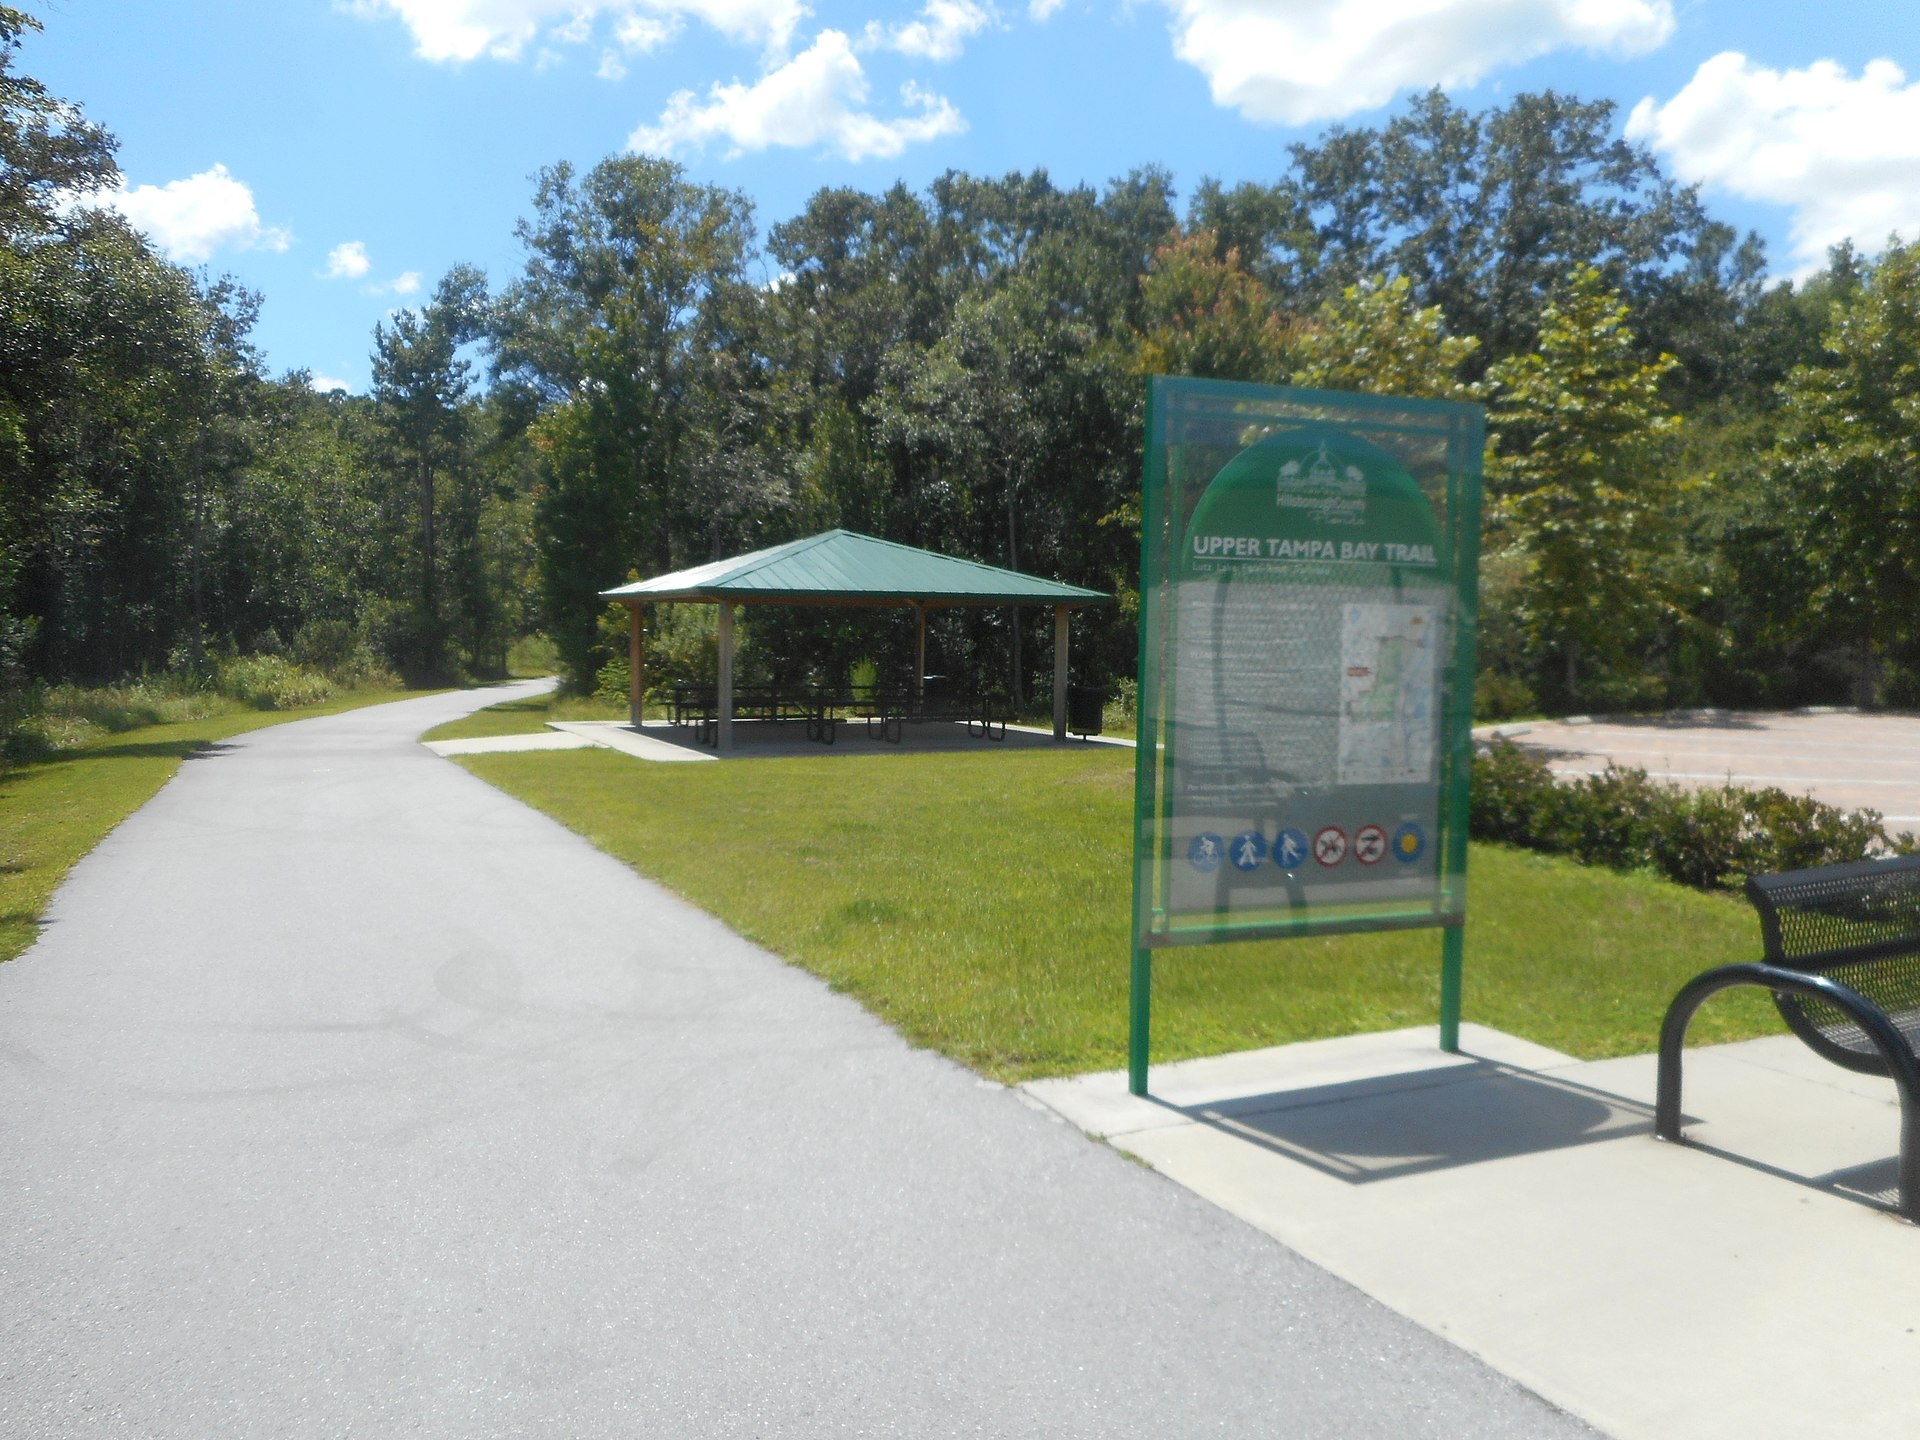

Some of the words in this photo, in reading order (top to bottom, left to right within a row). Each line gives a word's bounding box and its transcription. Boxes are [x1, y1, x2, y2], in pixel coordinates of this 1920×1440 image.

[1193, 535, 1260, 555] UPPER
[1266, 538, 1335, 558] TAMPA
[1341, 541, 1379, 559] BAY
[1384, 543, 1438, 563] TRAIL
